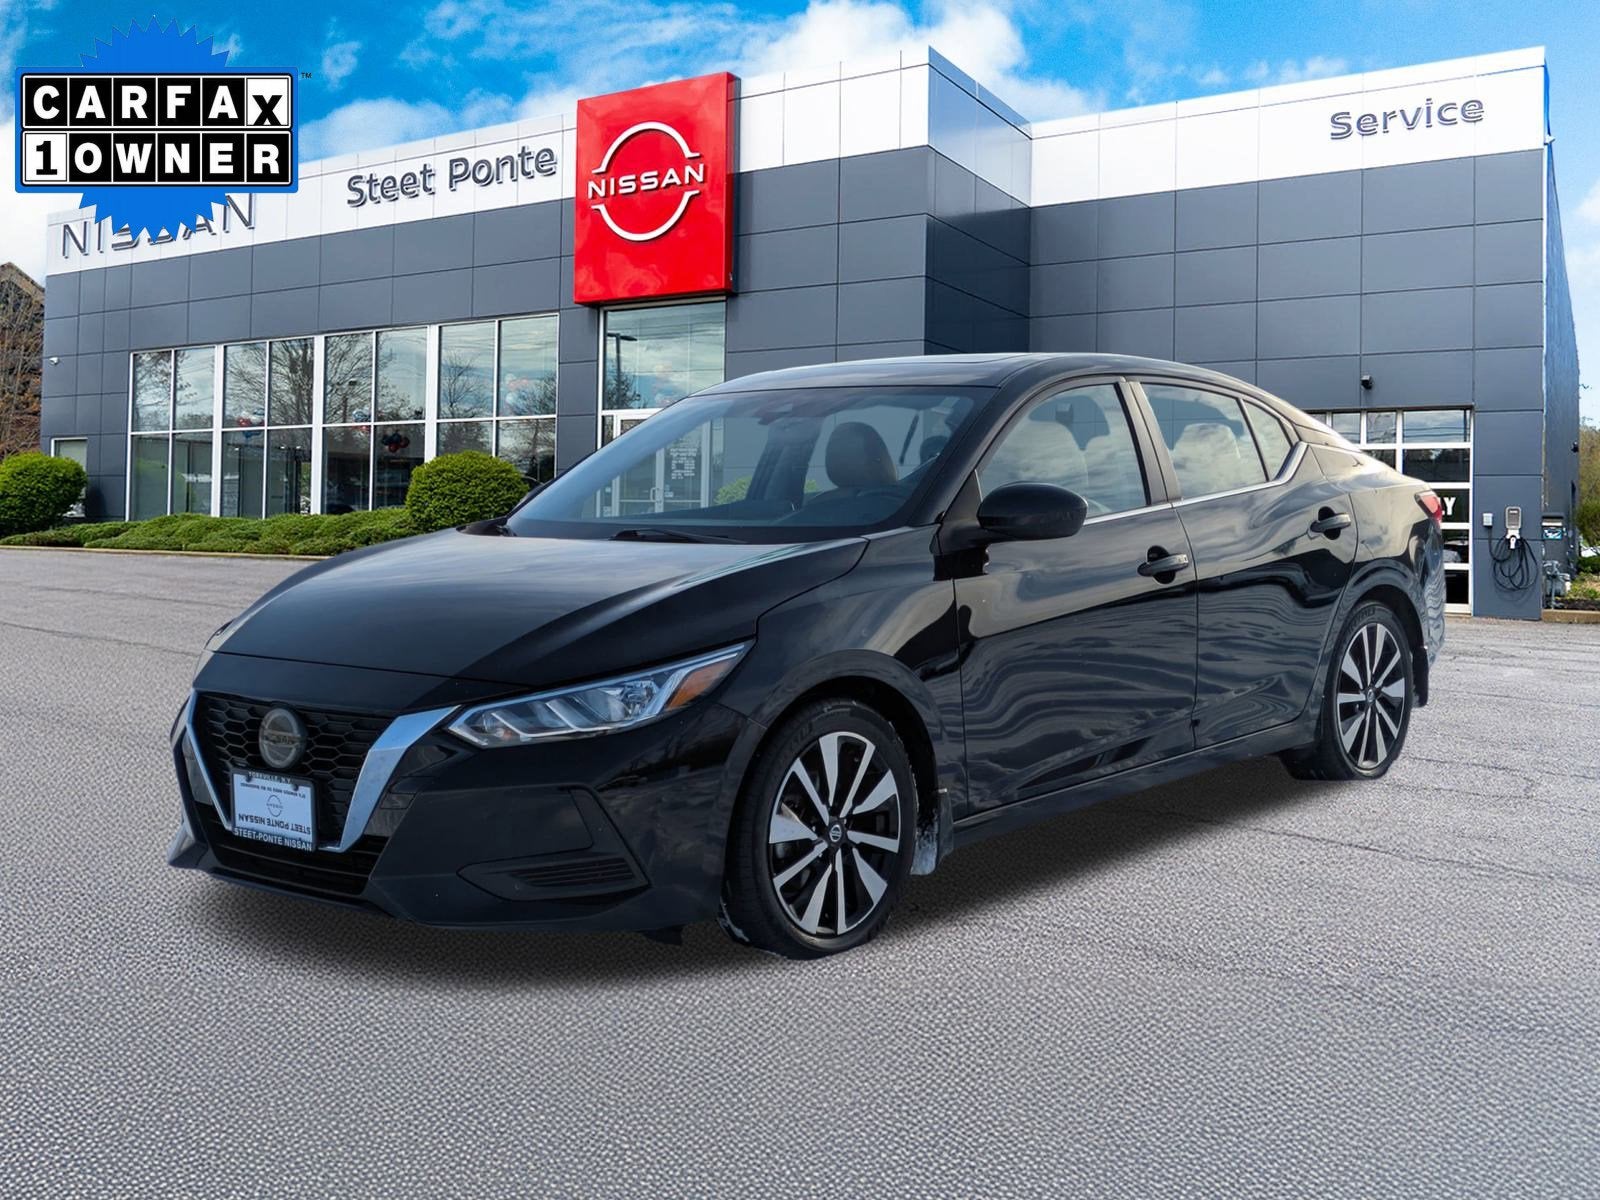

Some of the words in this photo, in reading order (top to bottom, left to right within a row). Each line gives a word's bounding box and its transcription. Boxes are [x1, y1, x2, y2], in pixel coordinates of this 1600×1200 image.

[1330, 97, 1484, 140] Service
[347, 162, 436, 207] Steet
[449, 145, 558, 191] Ponte
[587, 163, 705, 200] NISSAN
[62, 193, 255, 259] NIAN
[284, 837, 312, 851] NISSAN
